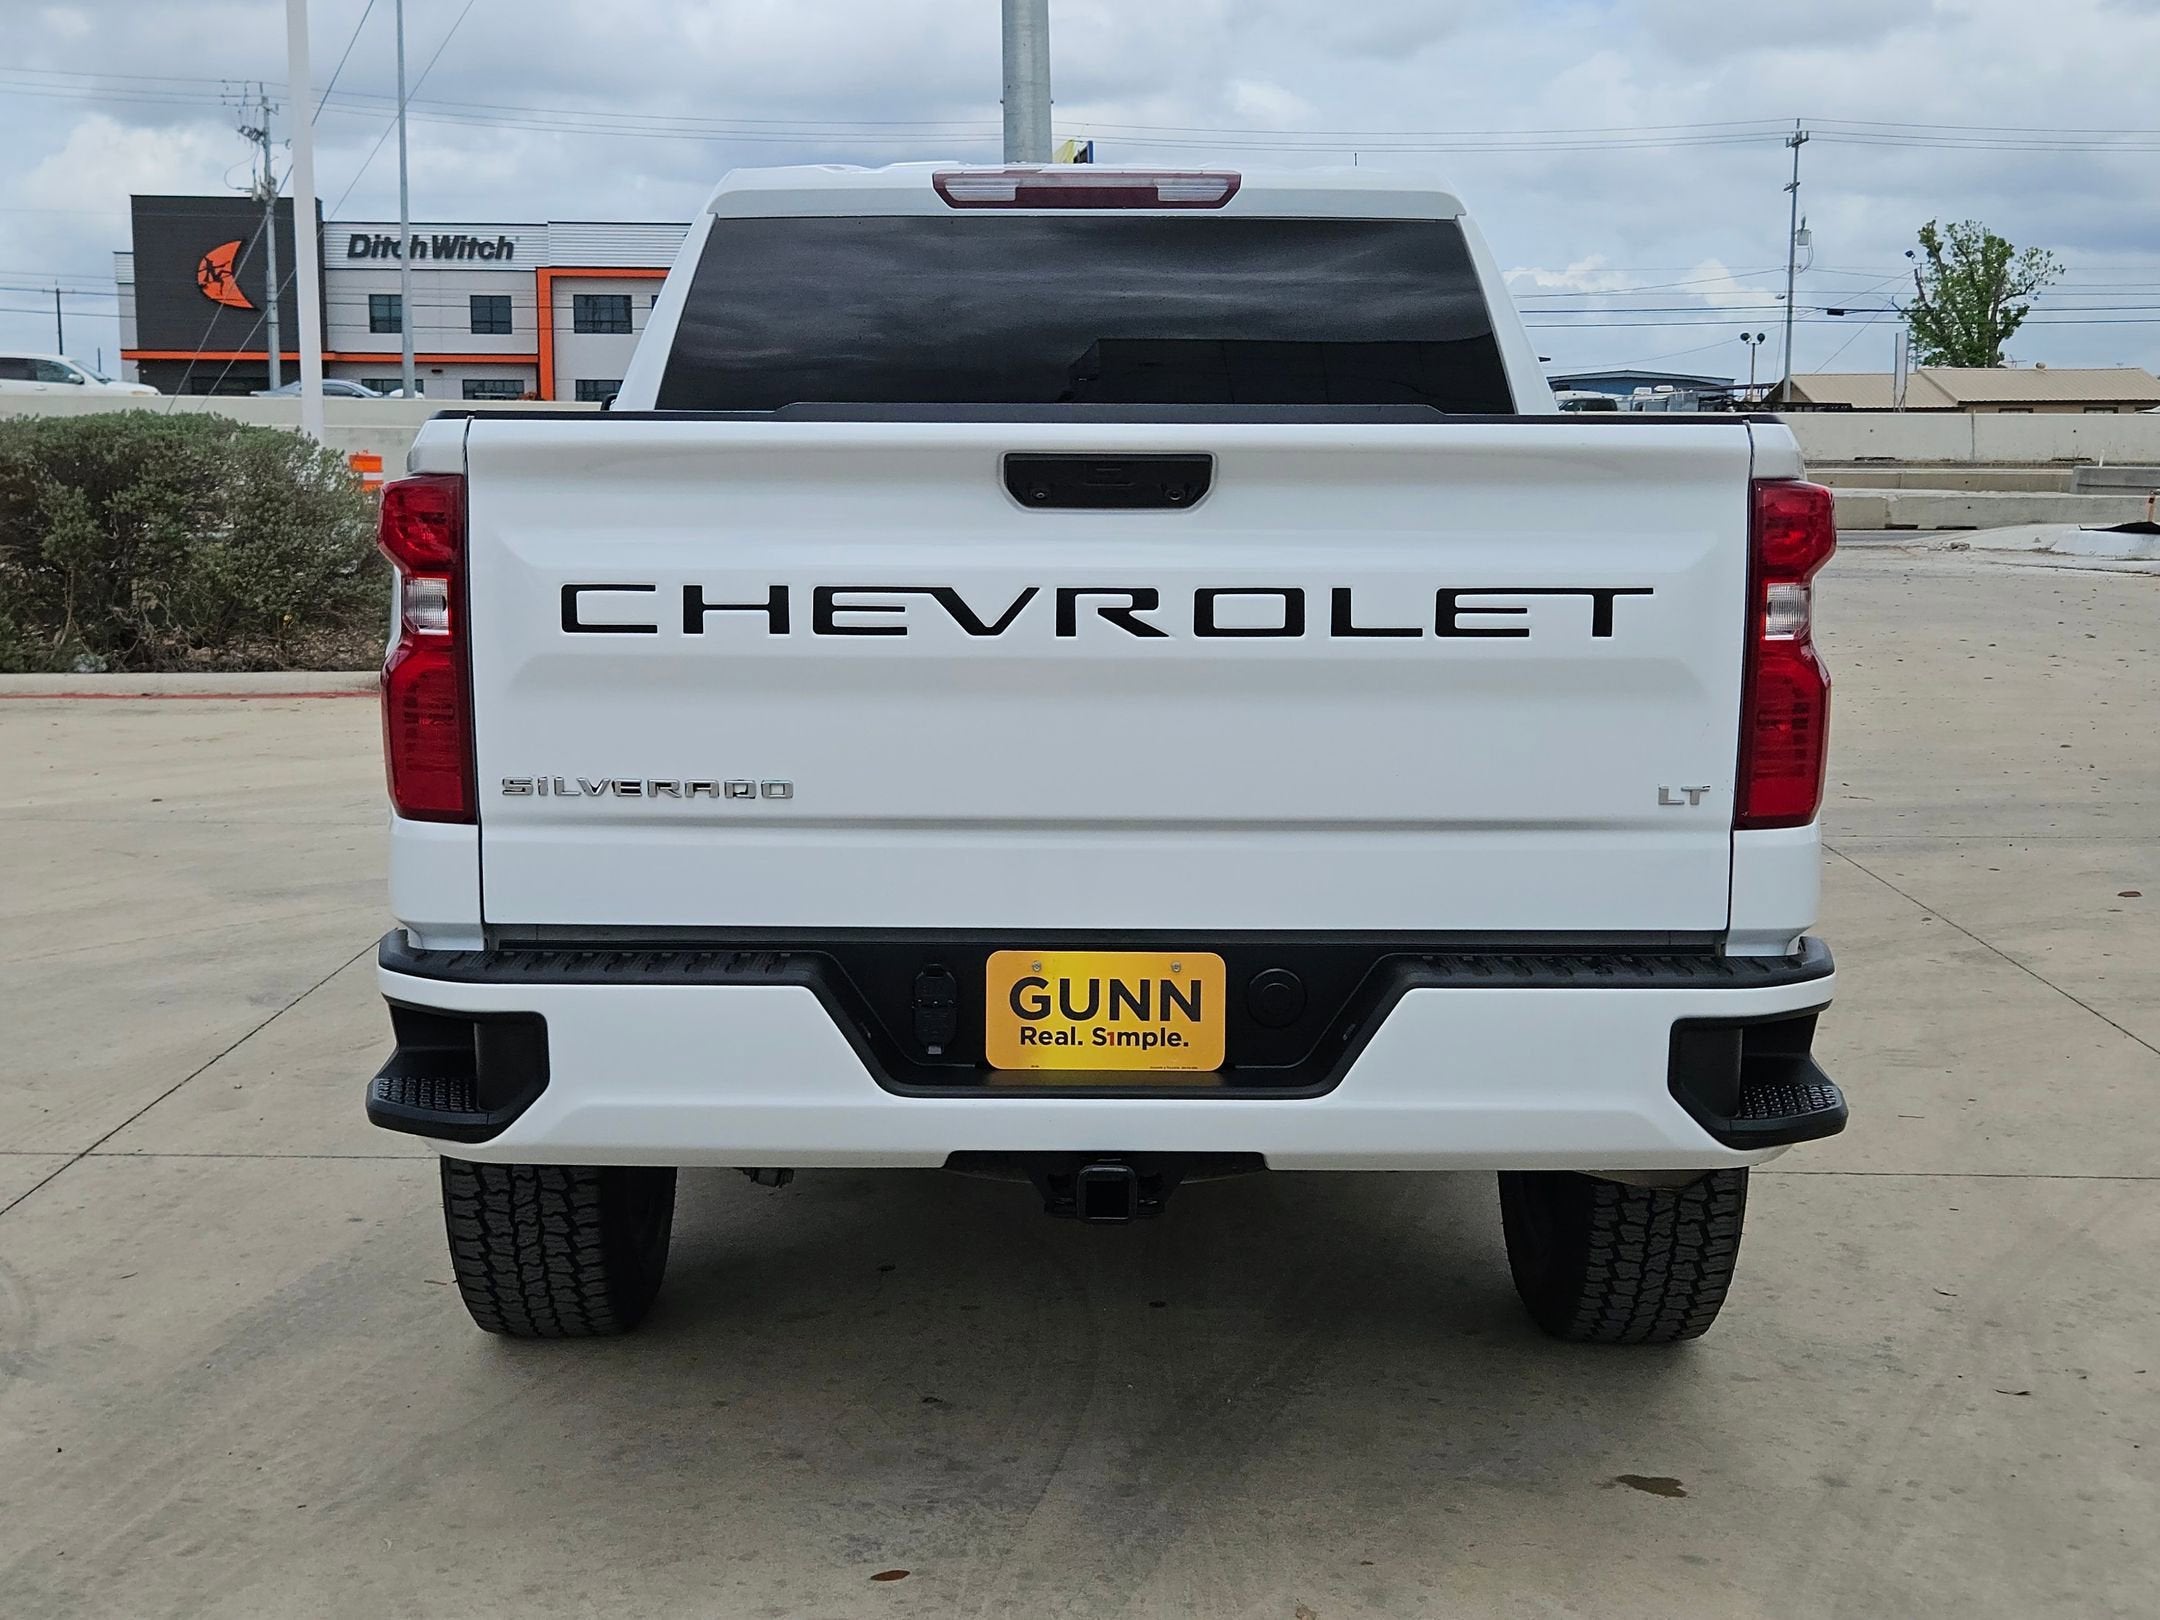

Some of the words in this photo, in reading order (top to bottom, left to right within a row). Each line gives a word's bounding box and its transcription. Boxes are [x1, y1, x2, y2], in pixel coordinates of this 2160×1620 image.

[347, 233, 428, 260] Ditch
[431, 234, 515, 261] Witch
[560, 583, 1655, 638] CHEVROLET
[501, 776, 794, 799] SILVERADO
[1657, 784, 1711, 806] LT
[1009, 976, 1202, 1022] GUNN
[1020, 1026, 1083, 1046] Real.
